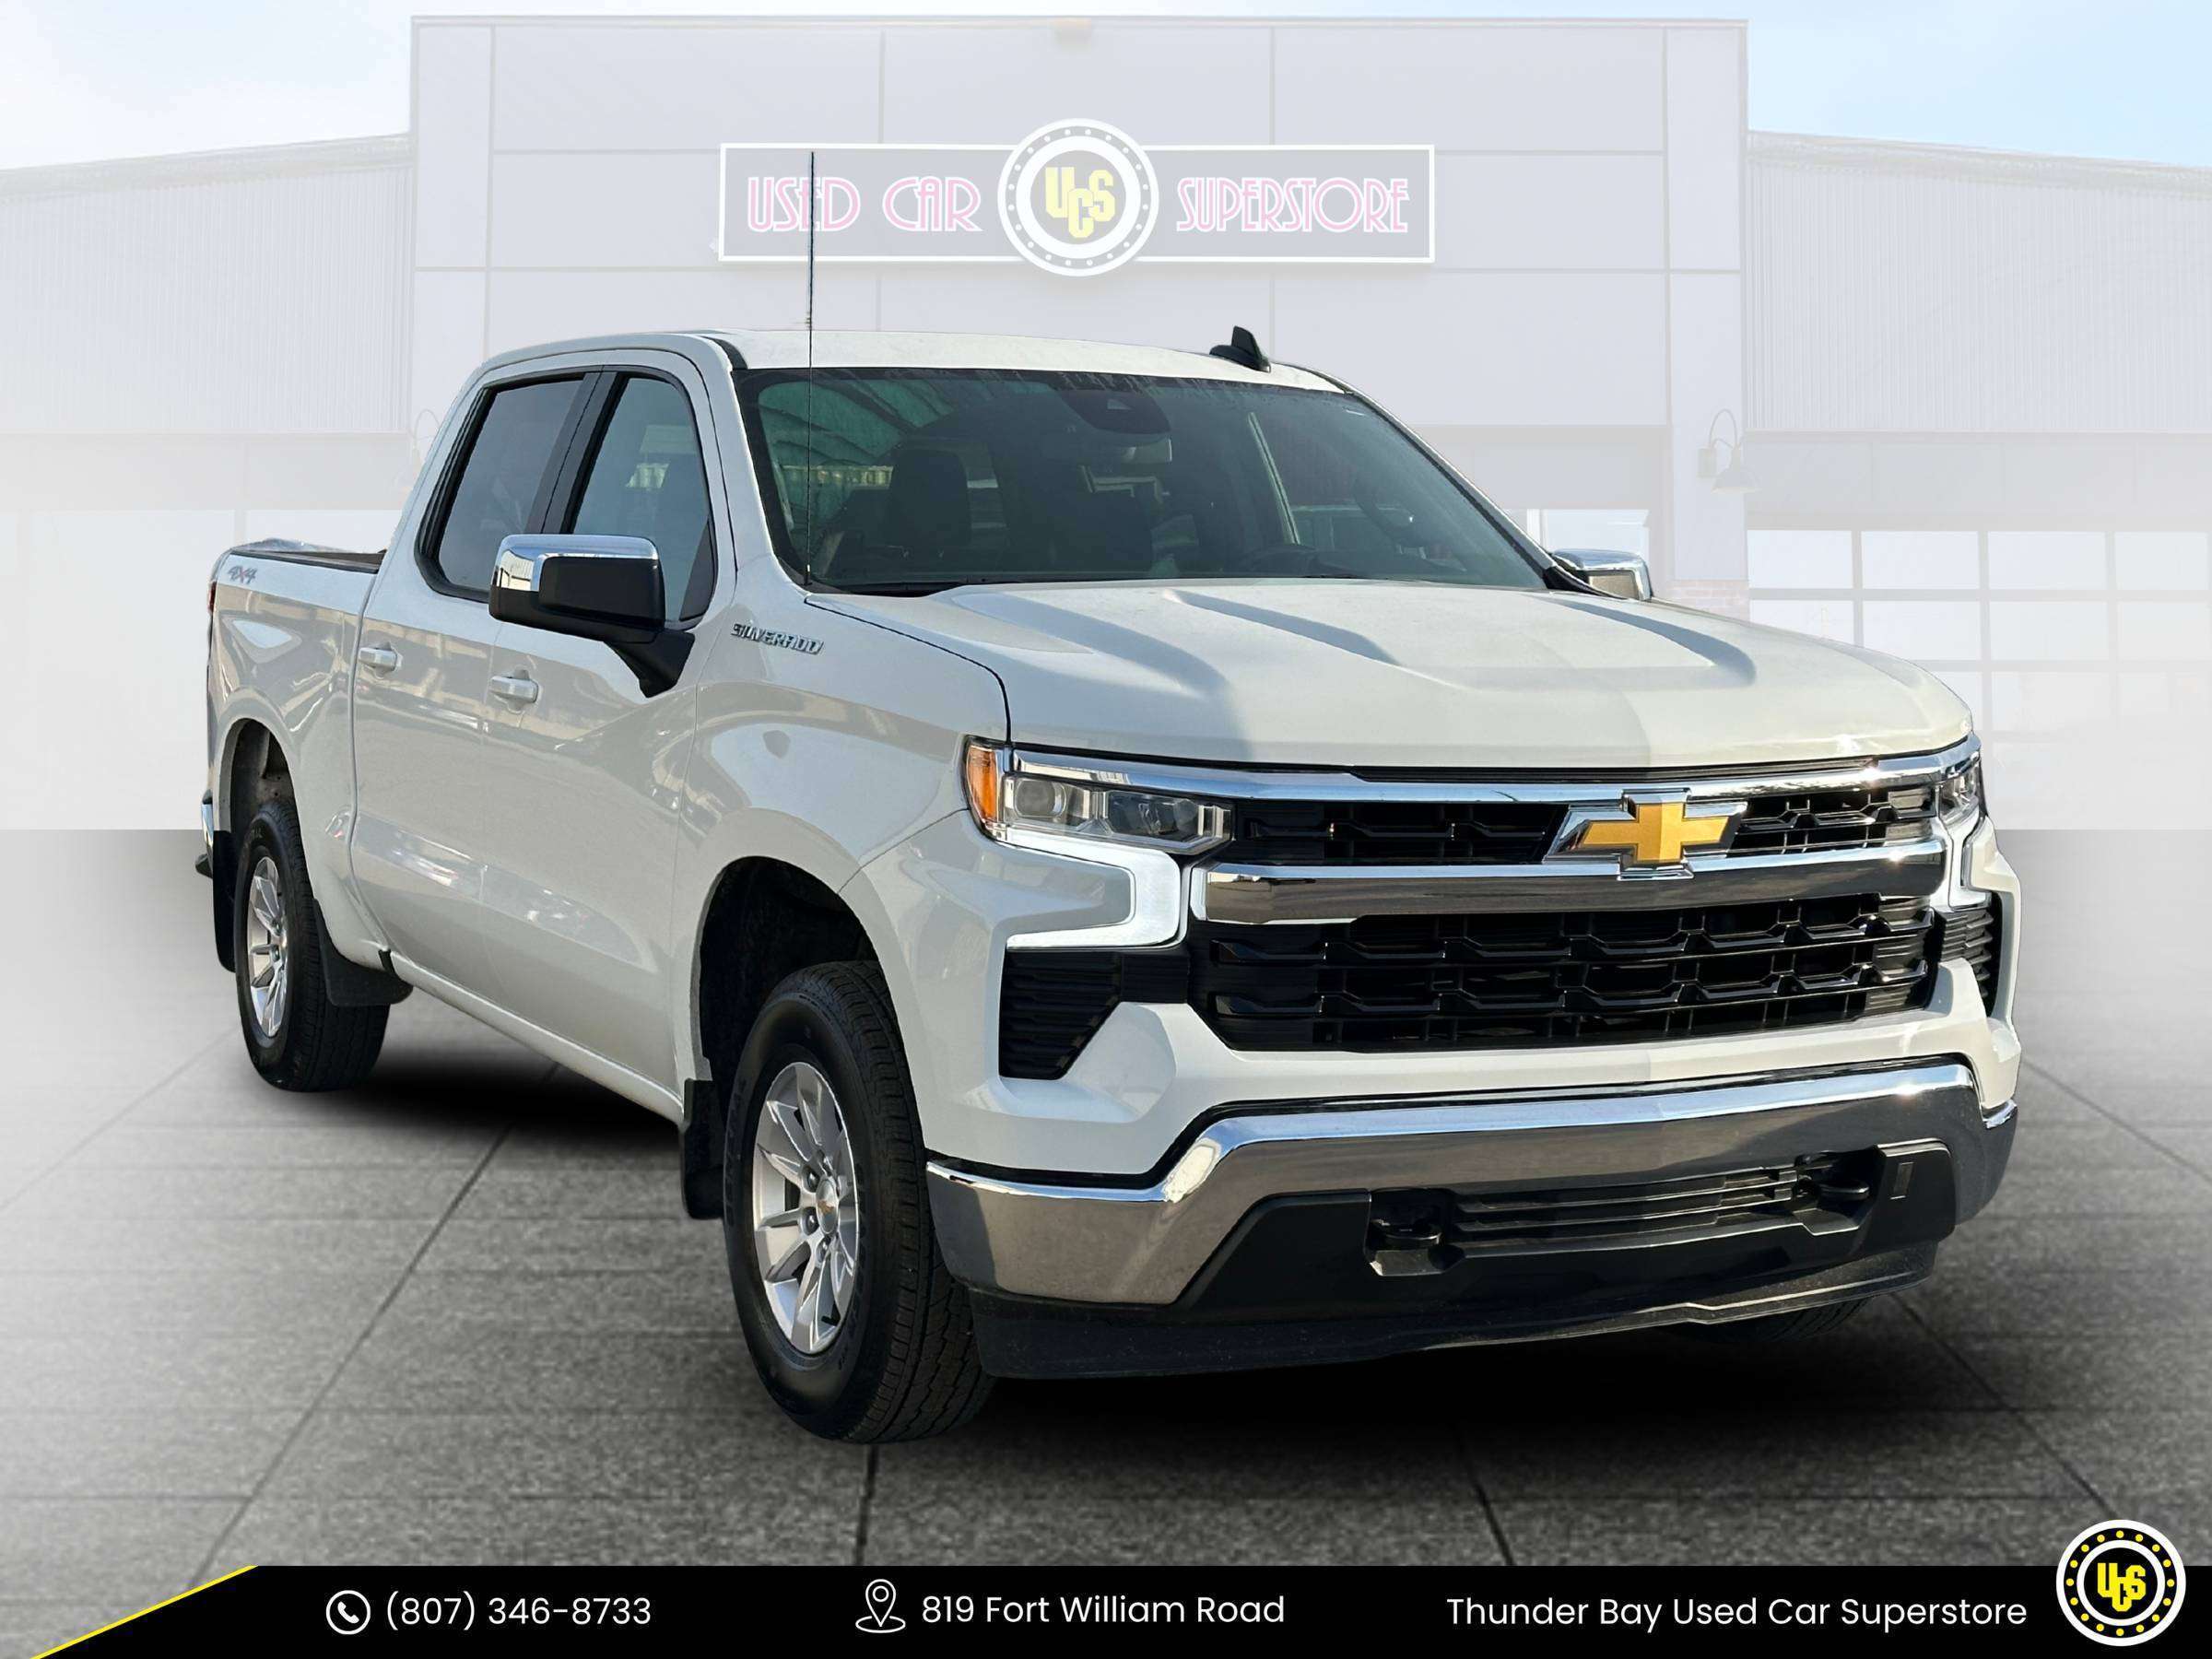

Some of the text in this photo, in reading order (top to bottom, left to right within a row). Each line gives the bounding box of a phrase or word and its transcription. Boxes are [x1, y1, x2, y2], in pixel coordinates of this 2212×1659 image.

[747, 175, 983, 232] USED CAR
[1176, 176, 1409, 233] SUPERSTORE
[731, 623, 824, 655] SILVERADO
